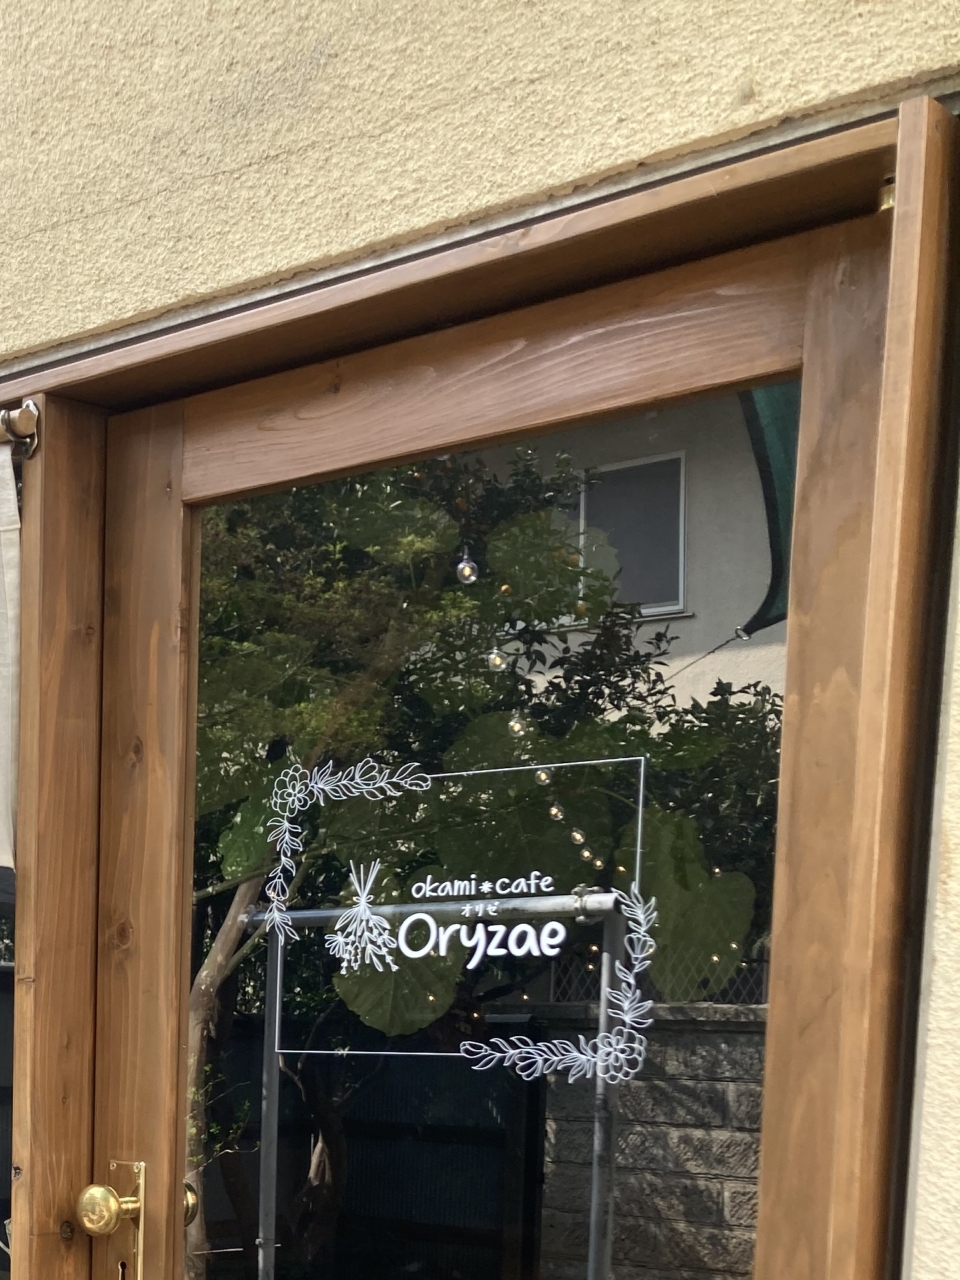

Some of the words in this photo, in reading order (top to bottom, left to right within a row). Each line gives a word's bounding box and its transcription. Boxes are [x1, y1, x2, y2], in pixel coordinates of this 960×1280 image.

[461, 902, 500, 917] オリゼ
[398, 912, 567, 970] Oryzae
